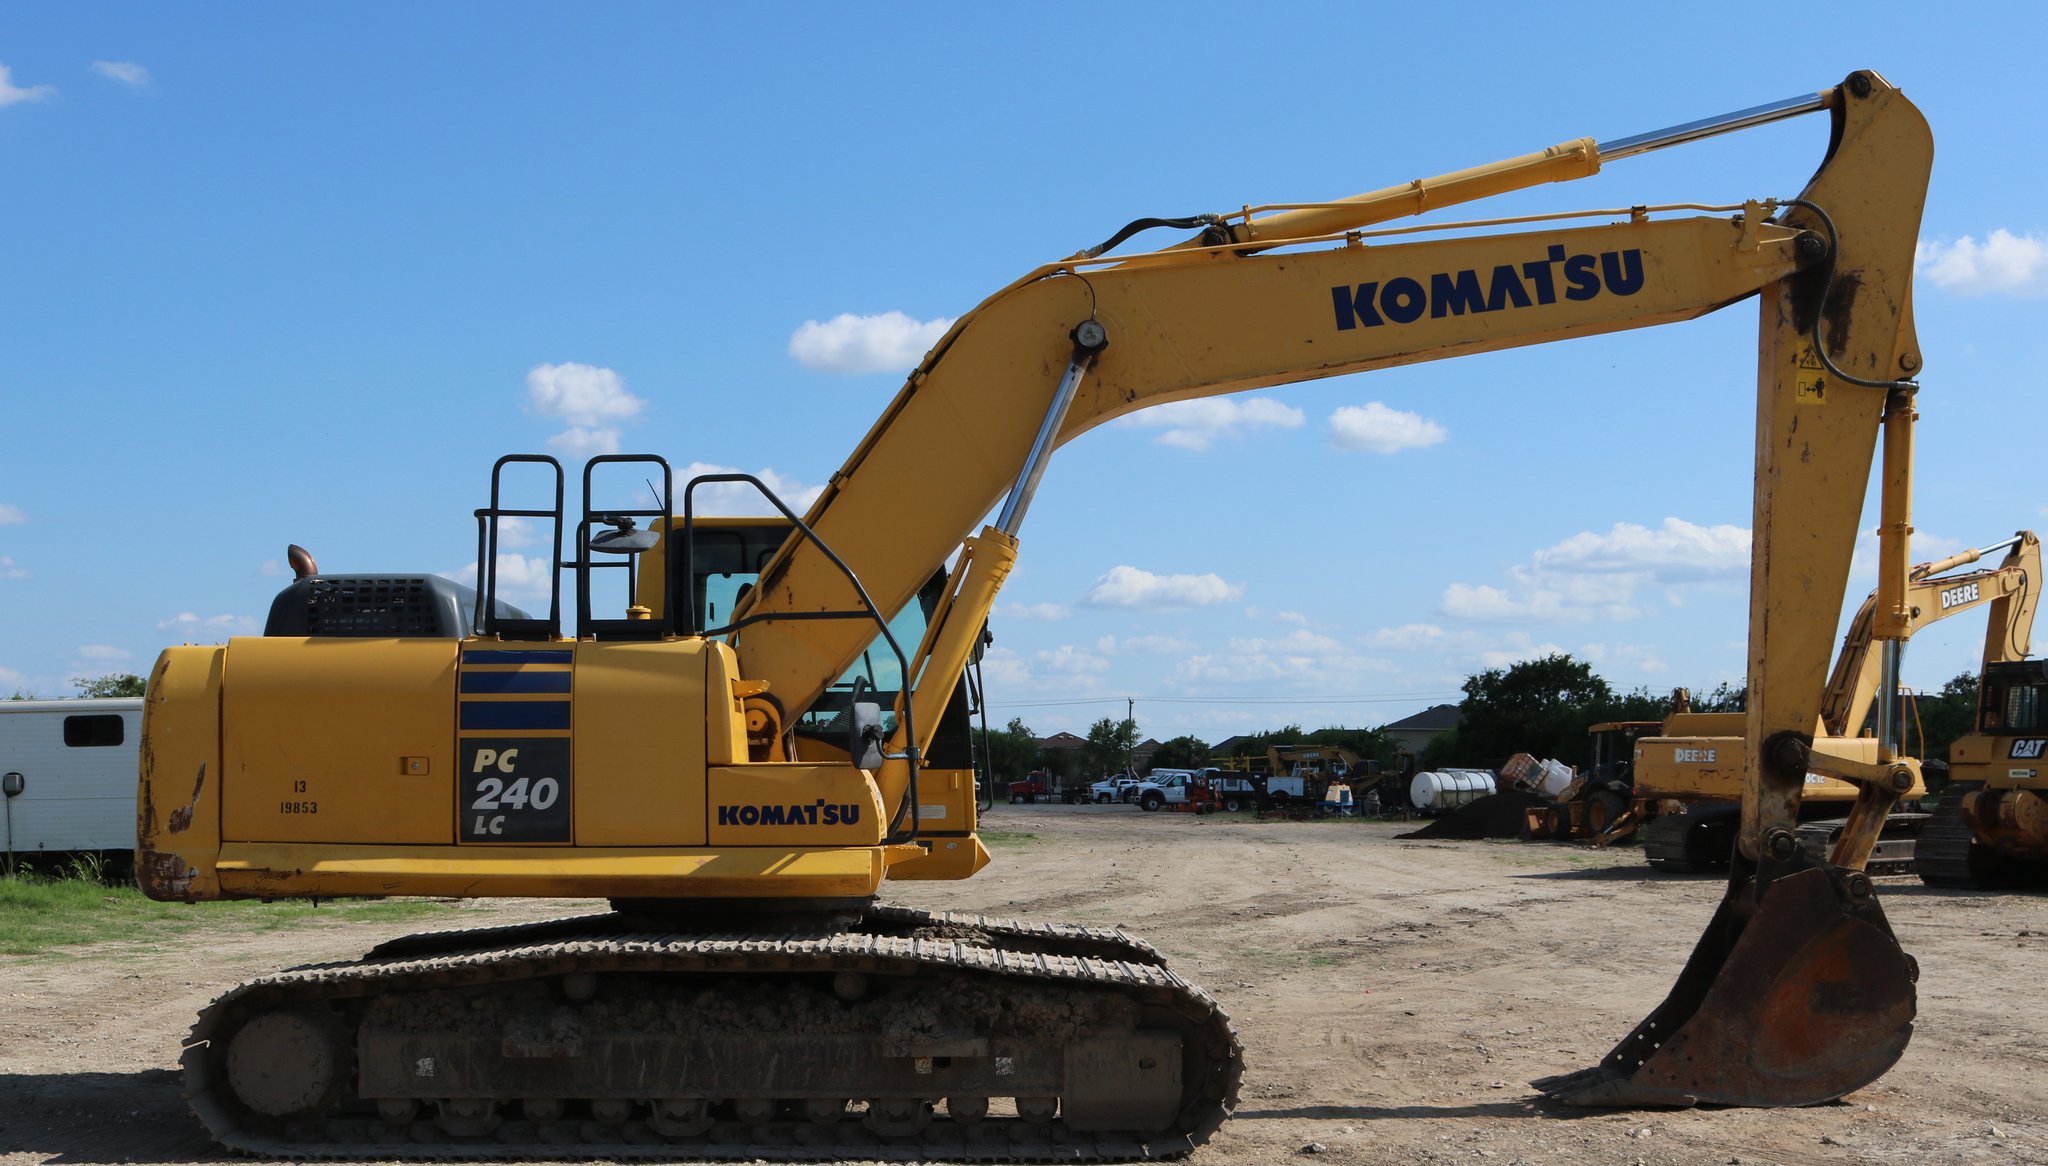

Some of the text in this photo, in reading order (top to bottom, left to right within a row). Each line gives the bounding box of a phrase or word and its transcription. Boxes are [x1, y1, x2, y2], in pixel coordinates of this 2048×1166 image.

[1331, 244, 1645, 331] KOMATSU
[1941, 582, 1979, 609] DEERE
[473, 748, 518, 773] PC
[2011, 739, 2046, 757] CAT
[294, 780, 307, 793] 13
[471, 777, 559, 810] 240
[280, 801, 318, 814] 19853
[718, 799, 860, 826] KOMATSU
[473, 815, 506, 835] LC
